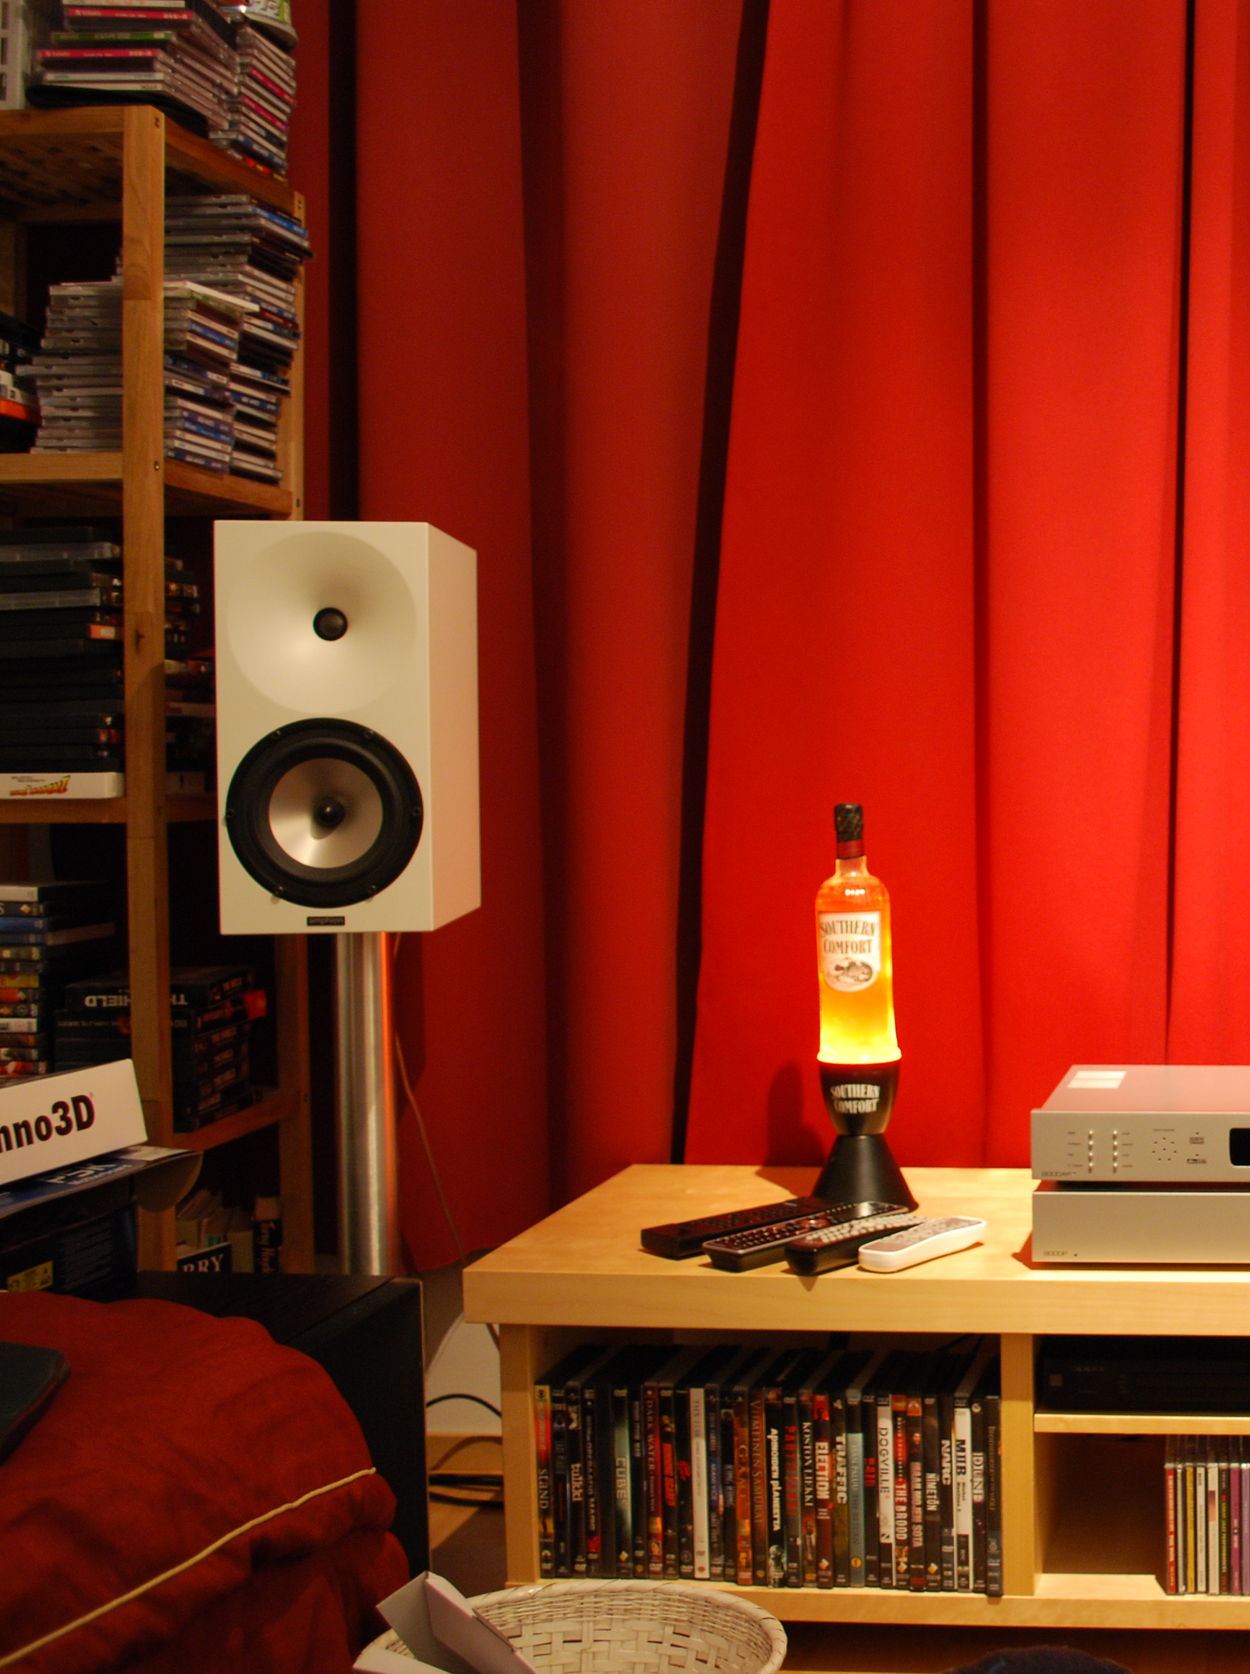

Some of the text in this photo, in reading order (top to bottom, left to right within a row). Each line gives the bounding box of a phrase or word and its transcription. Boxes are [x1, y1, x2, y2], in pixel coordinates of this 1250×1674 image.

[819, 919, 876, 937] SOUTHERN
[823, 939, 873, 955] COMFORT
[830, 1084, 881, 1099] SOUTHERN
[833, 1099, 880, 1114] COMFORT
[647, 1434, 656, 1470] WATER
[750, 1400, 763, 1524] VIIMEINEN SAMURAI
[802, 1422, 813, 1506] KOSTON LIEKKI
[815, 1441, 830, 1499] ELECTION
[836, 1433, 847, 1504] TRAFFIC
[880, 1428, 889, 1494] DOGVILLE
[941, 1440, 951, 1485] NARC
[895, 1482, 906, 1502] THE
[895, 1505, 908, 1541] BROOD
[912, 1525, 923, 1548] SOTA
